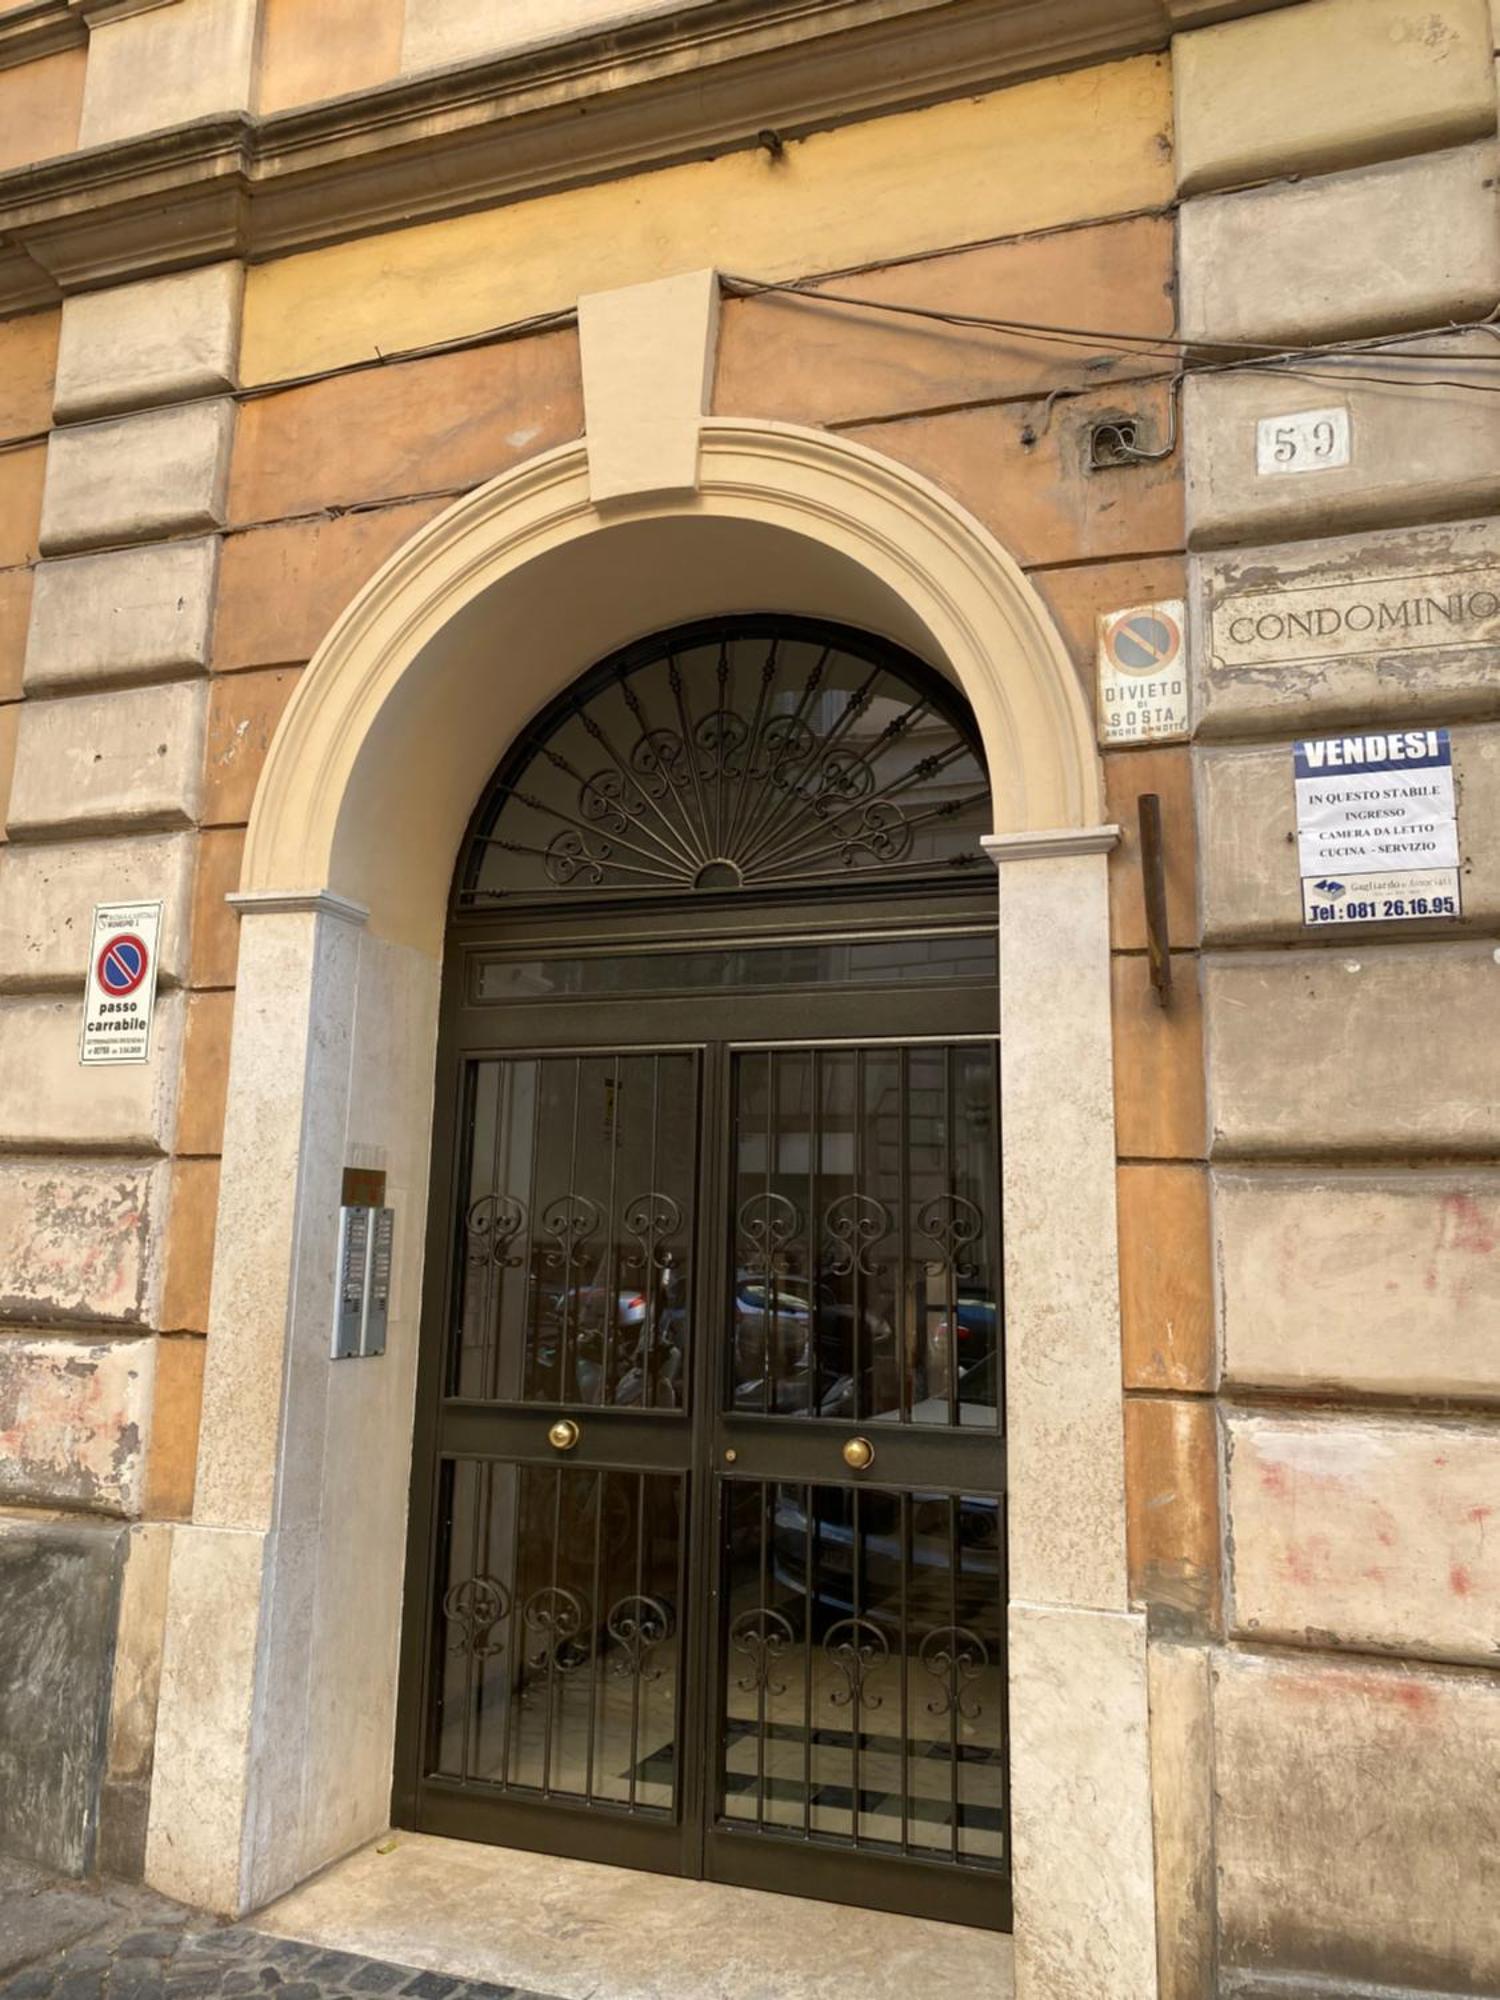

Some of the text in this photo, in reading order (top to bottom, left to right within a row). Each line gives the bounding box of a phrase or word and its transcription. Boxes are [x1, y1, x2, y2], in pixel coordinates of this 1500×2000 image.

[1274, 420, 1334, 463] 59
[1229, 591, 1499, 645] CONDOMINIO
[1105, 681, 1182, 702] DIVIETO
[1137, 700, 1148, 709] DI
[1111, 707, 1174, 727] SOSTA
[1106, 727, 1137, 737] ANCHE
[1303, 731, 1440, 768] VENDESI
[1308, 785, 1441, 805] IN QUESTO STABILE
[1345, 808, 1406, 821] INGRESSO
[1319, 824, 1435, 841] CAMERA DA LETTO
[1319, 847, 1366, 858] CUCINA
[1378, 842, 1436, 854] SERVIZIO
[1346, 901, 1376, 920] 081
[1383, 895, 1454, 917] 26.16.95
[99, 1001, 138, 1016] passo
[87, 1017, 147, 1032] carrabile
